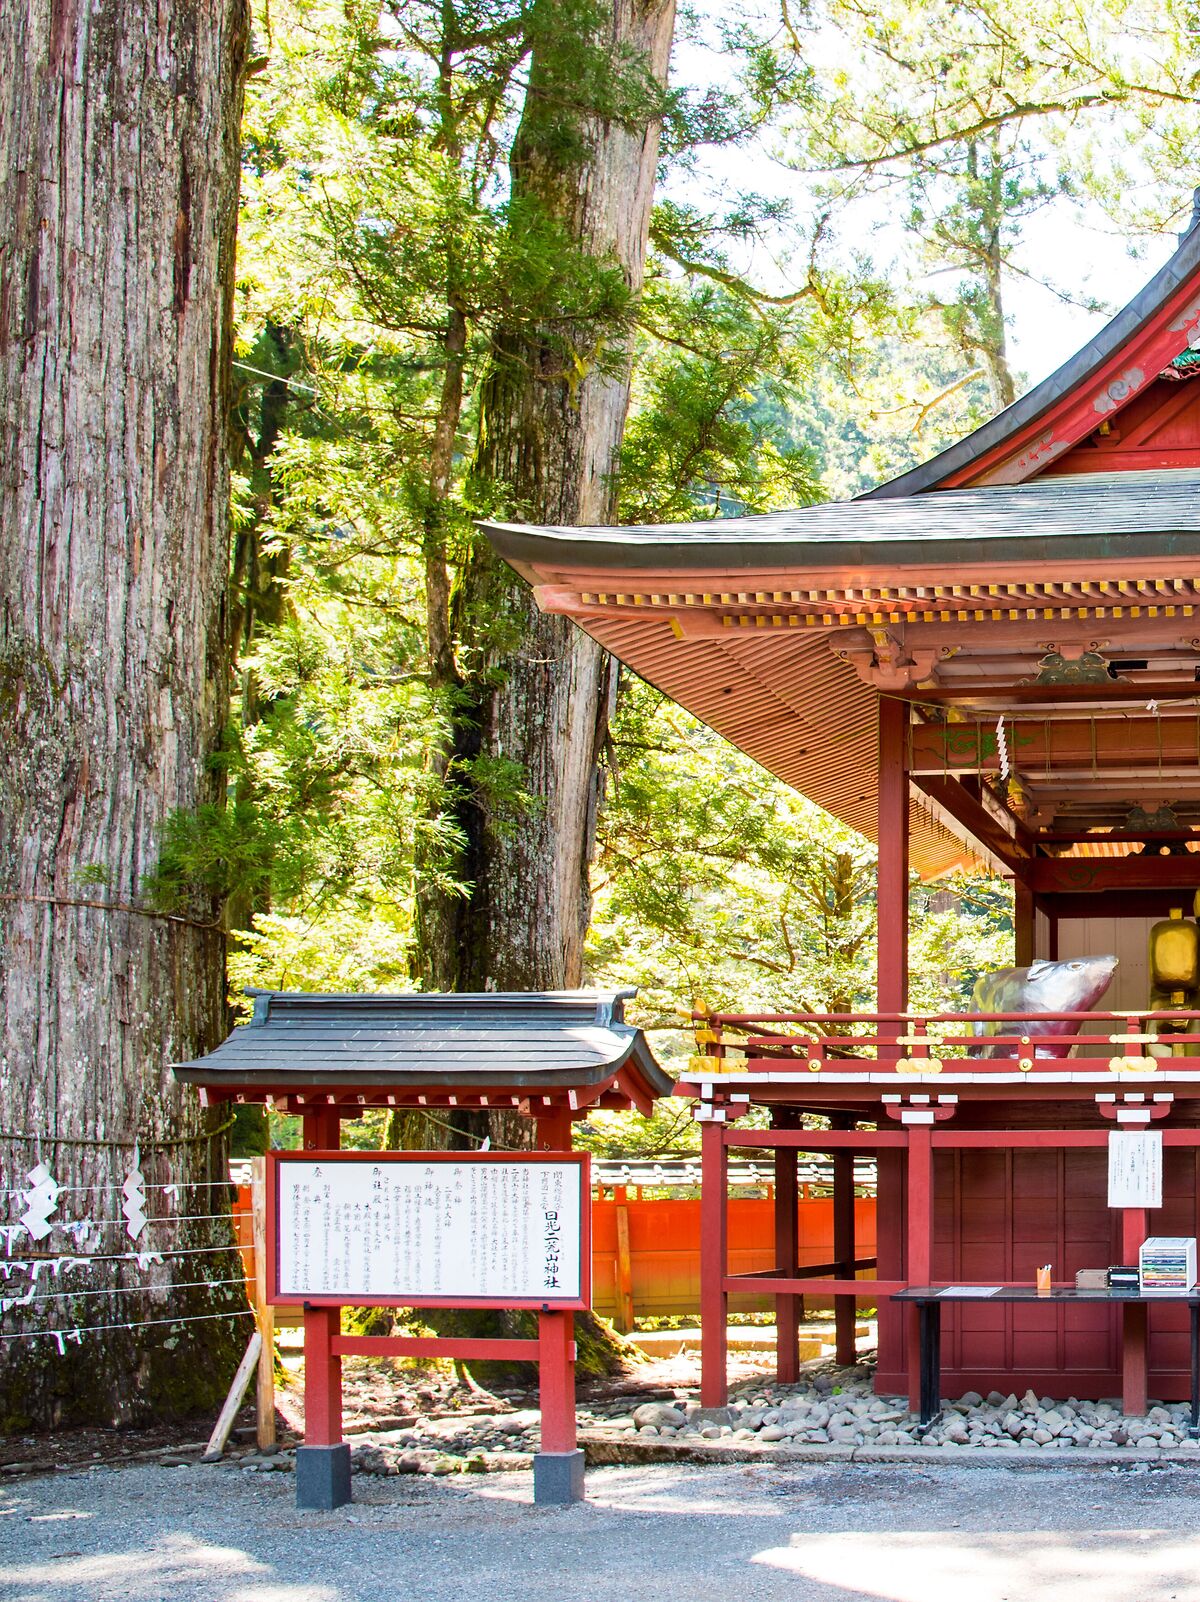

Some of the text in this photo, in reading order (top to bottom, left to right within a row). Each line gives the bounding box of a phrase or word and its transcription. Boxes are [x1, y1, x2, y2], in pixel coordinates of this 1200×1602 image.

[543, 1210, 562, 1289] 日光二荒山神社
